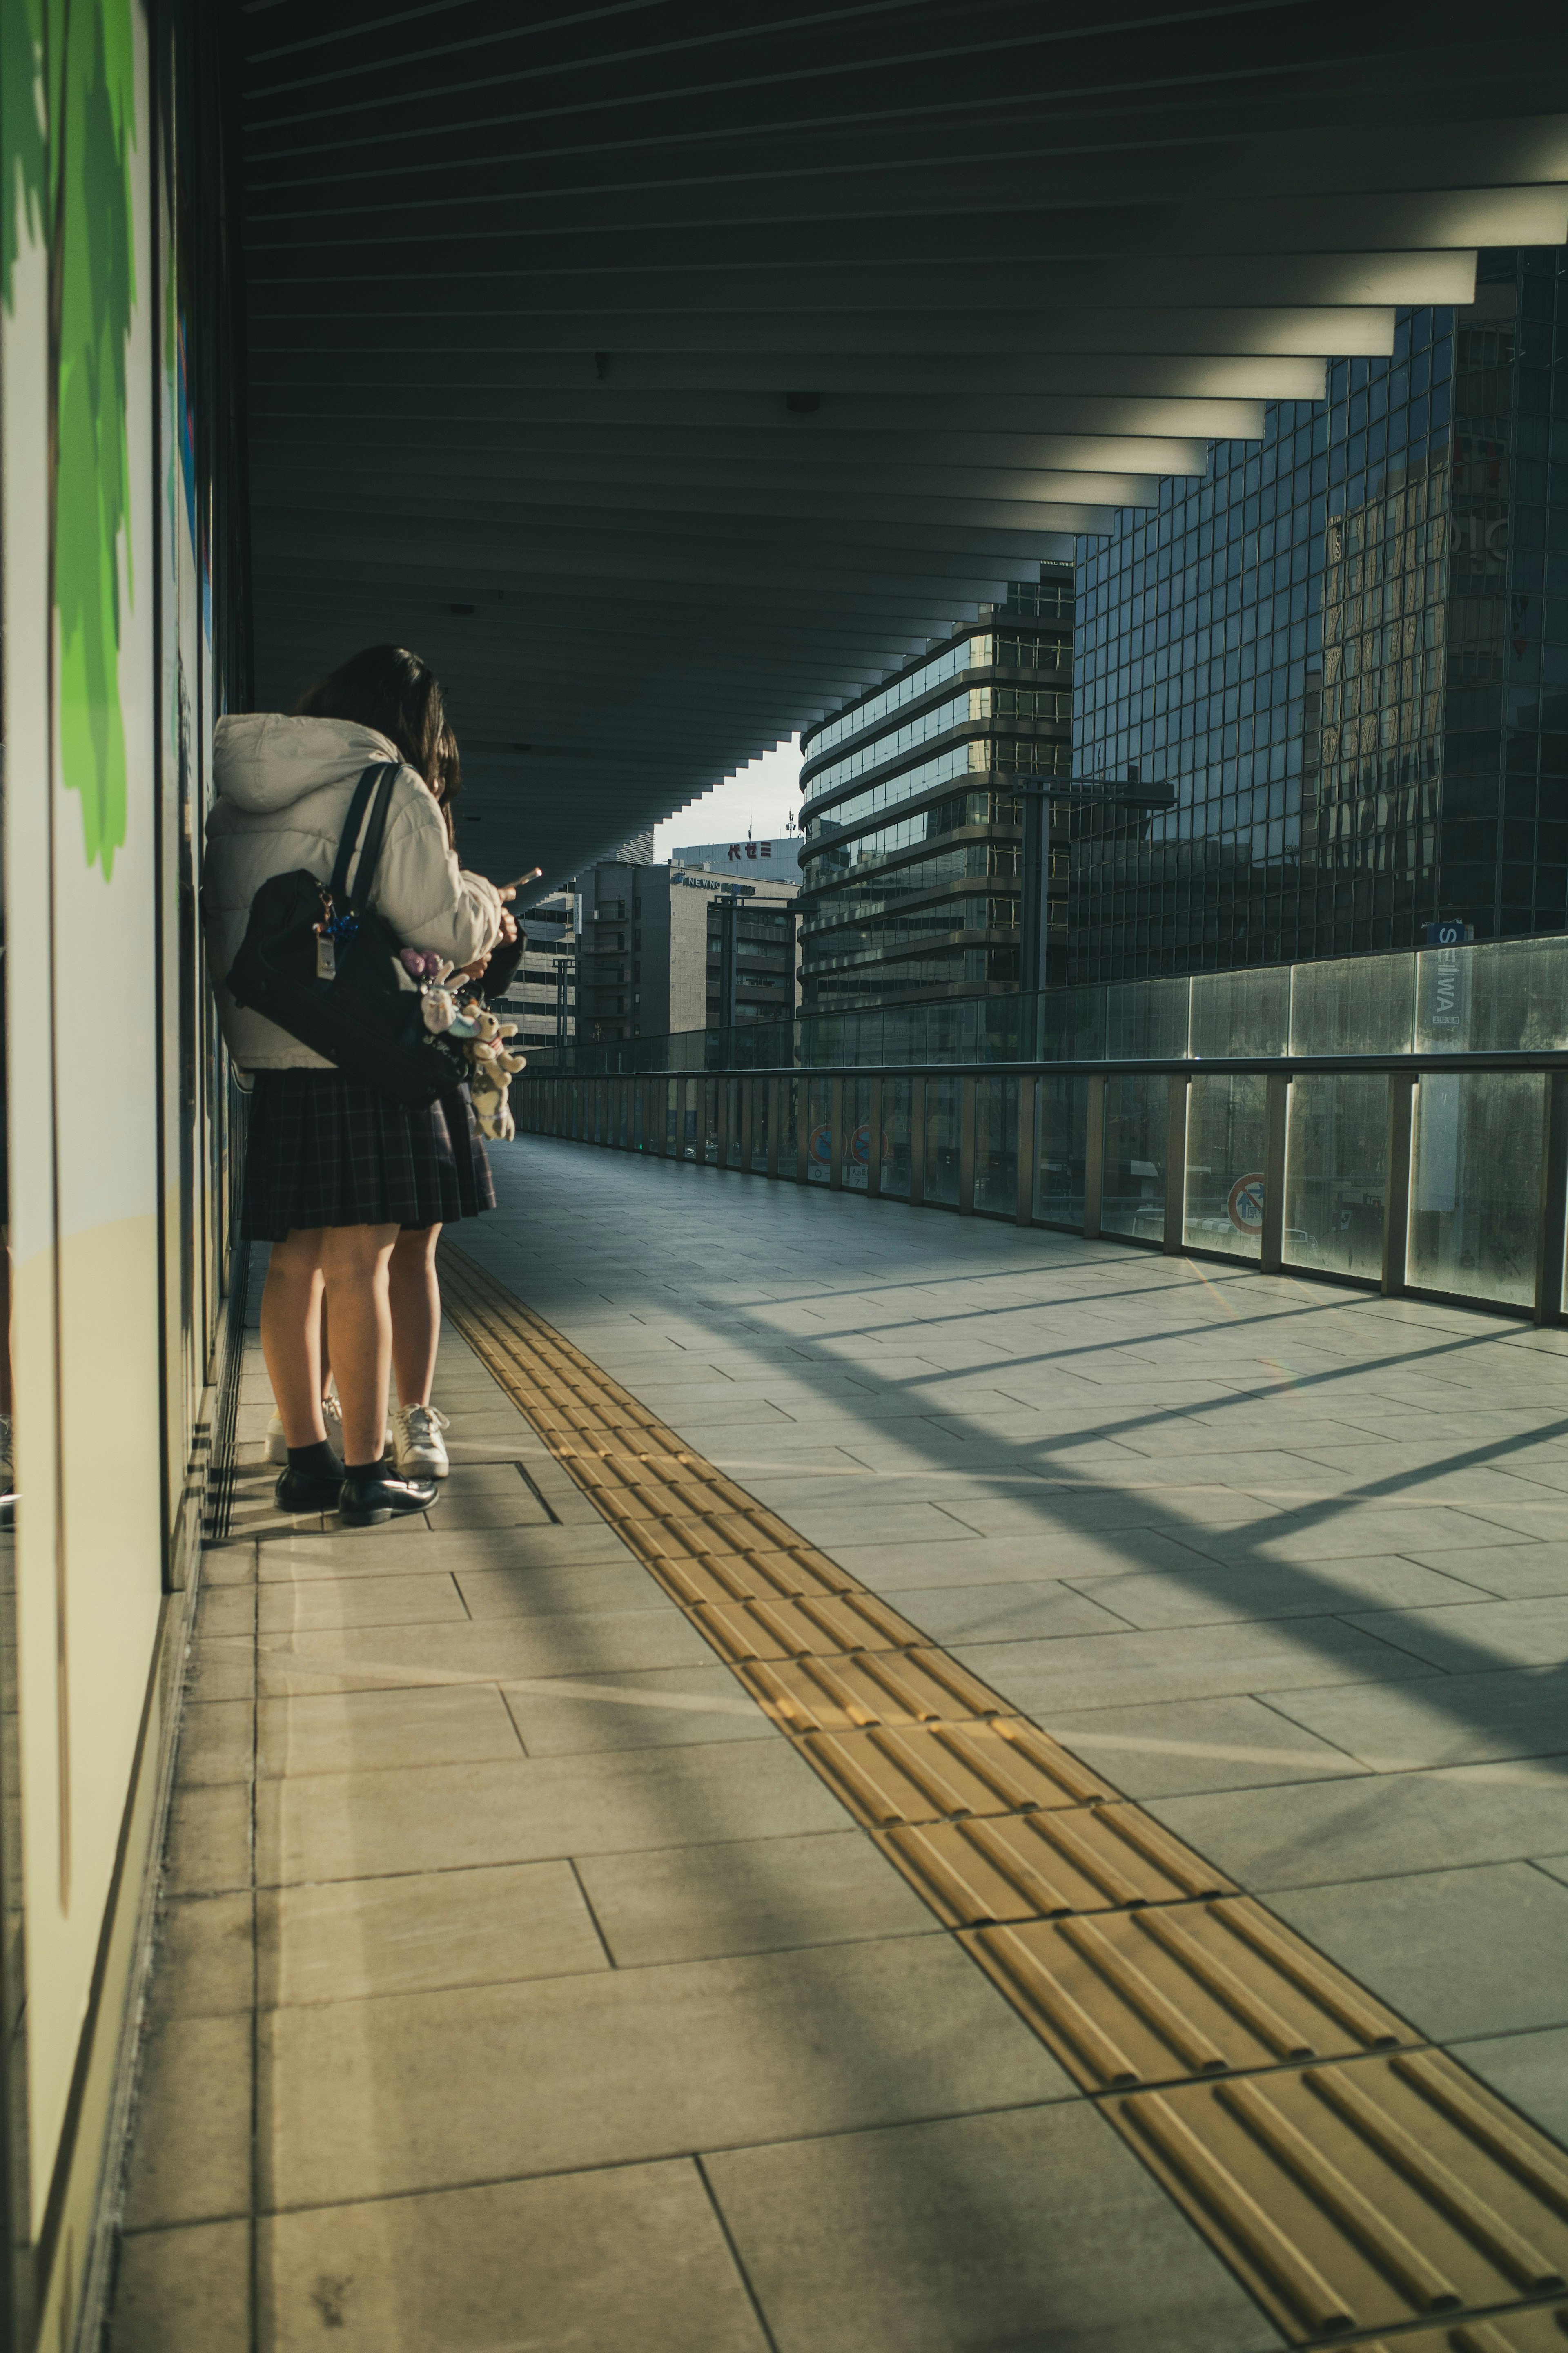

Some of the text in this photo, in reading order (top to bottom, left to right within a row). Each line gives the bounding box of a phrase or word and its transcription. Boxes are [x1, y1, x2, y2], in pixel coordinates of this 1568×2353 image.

[728, 842, 771, 860] 代ゼミ
[689, 877, 721, 889] NEWNO
